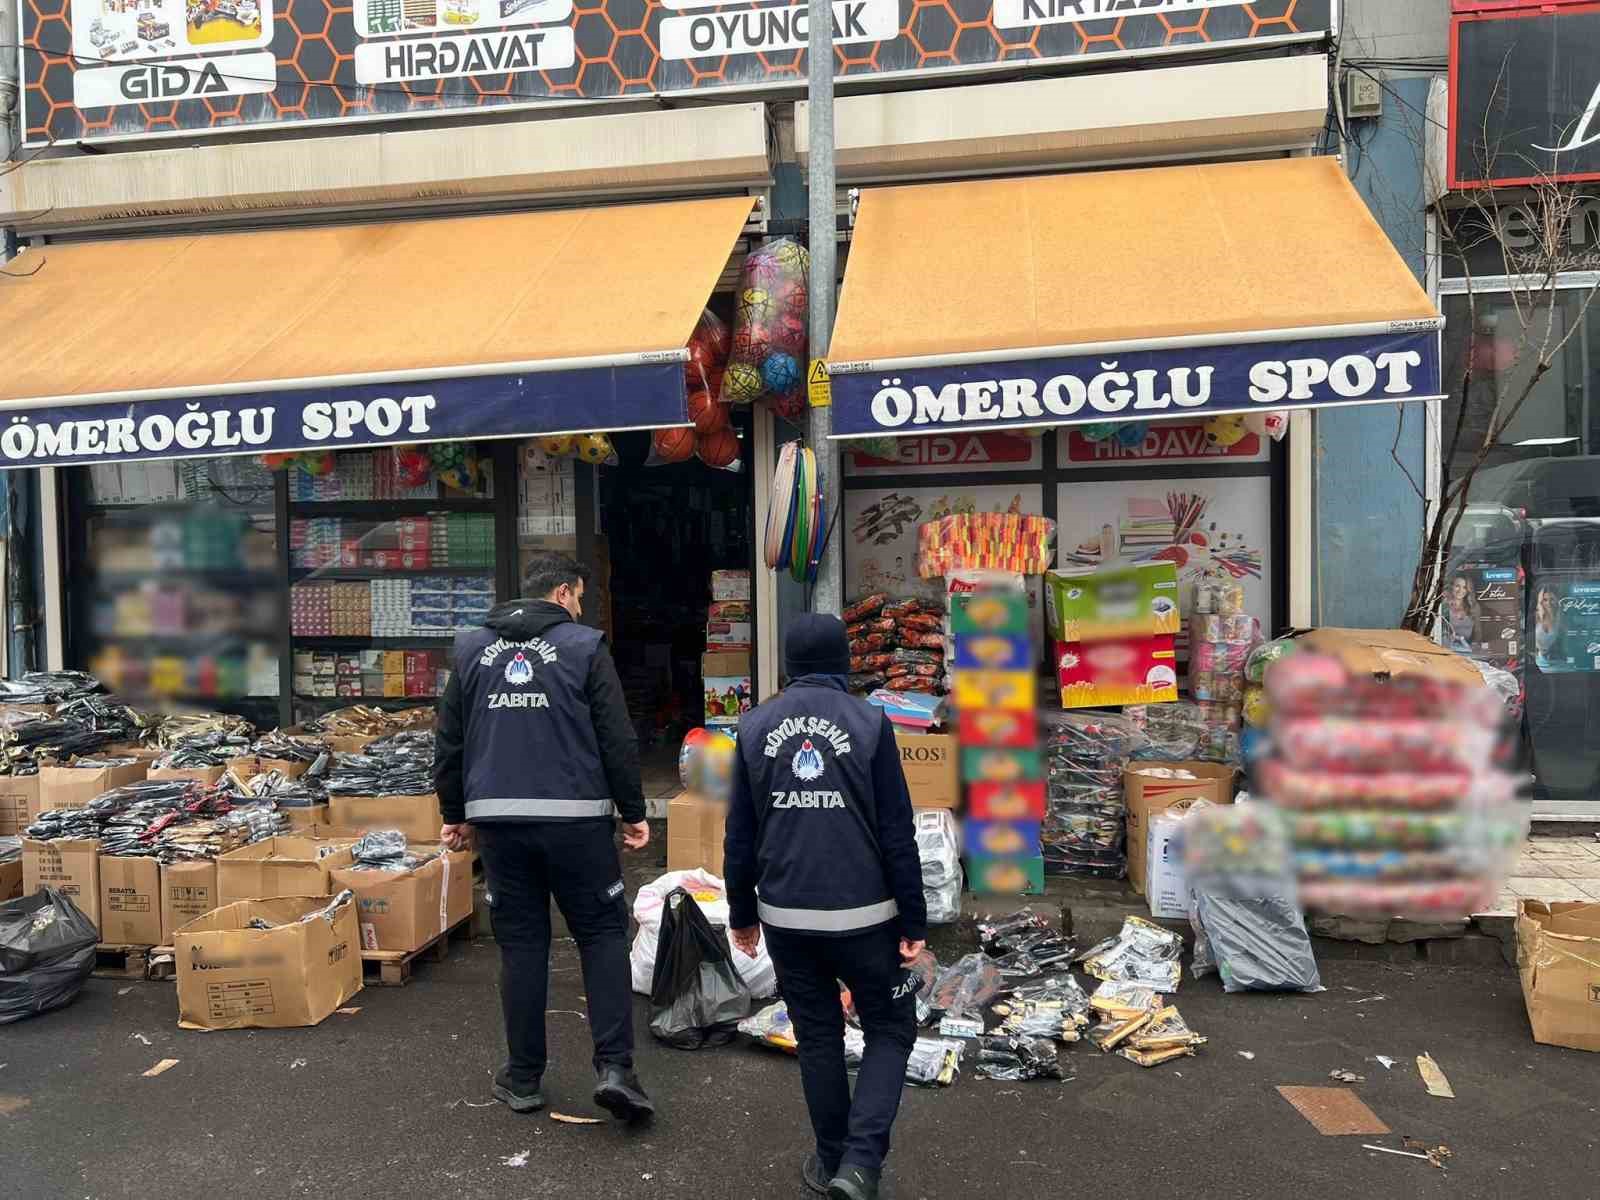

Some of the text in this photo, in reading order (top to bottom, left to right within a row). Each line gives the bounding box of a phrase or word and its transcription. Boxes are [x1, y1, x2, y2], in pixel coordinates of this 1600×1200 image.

[384, 33, 546, 79] HIRDAVAT
[119, 61, 229, 99] GIDA
[871, 351, 1422, 427] ÖMEROĞLU SPOT
[1, 395, 437, 459] ÖMEROĞLU SPOT
[895, 435, 991, 464] GIDA
[487, 692, 550, 709] ZABITA
[771, 790, 846, 809] ZABITA
